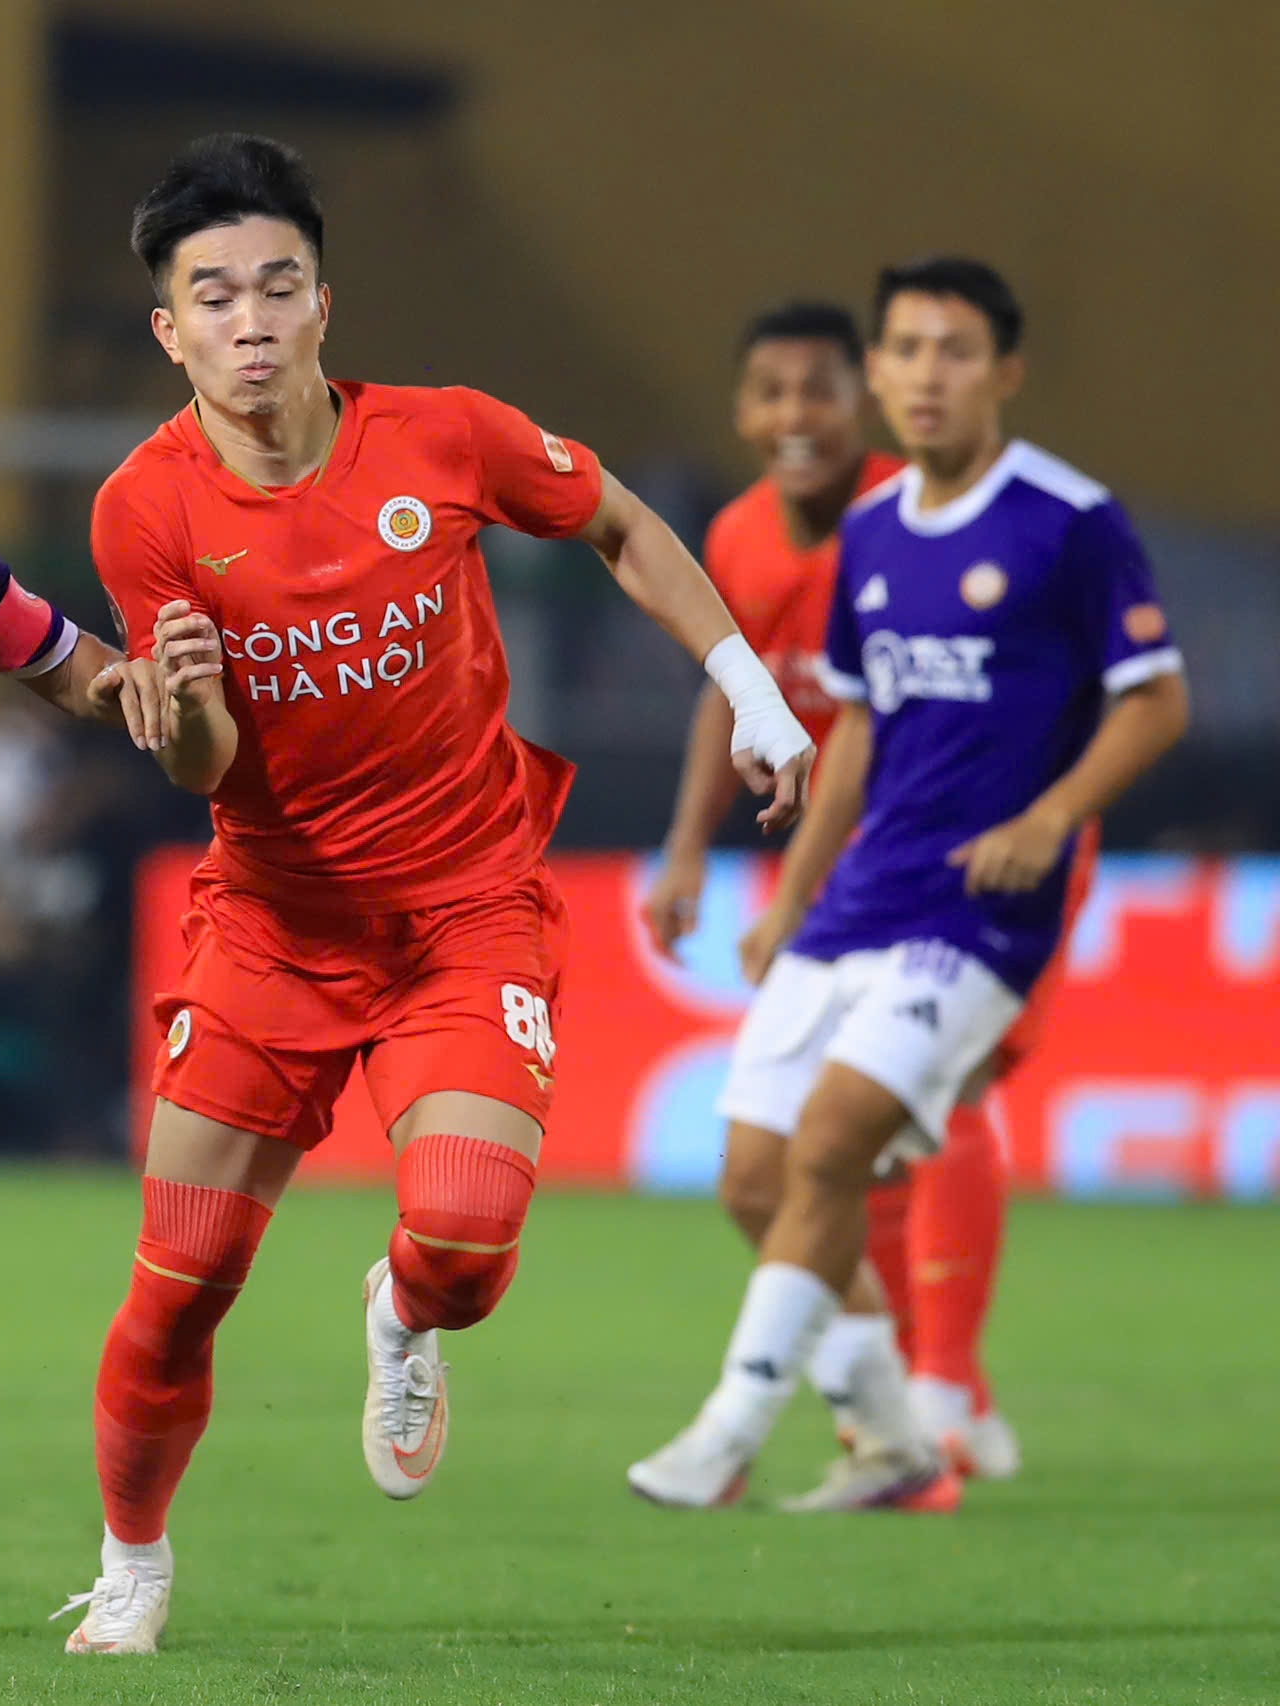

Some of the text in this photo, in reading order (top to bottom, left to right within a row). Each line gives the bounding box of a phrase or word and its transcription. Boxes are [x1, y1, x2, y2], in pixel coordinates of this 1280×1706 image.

[221, 584, 444, 663] CÔNG AN
[248, 641, 424, 702] HÀ NỘI
